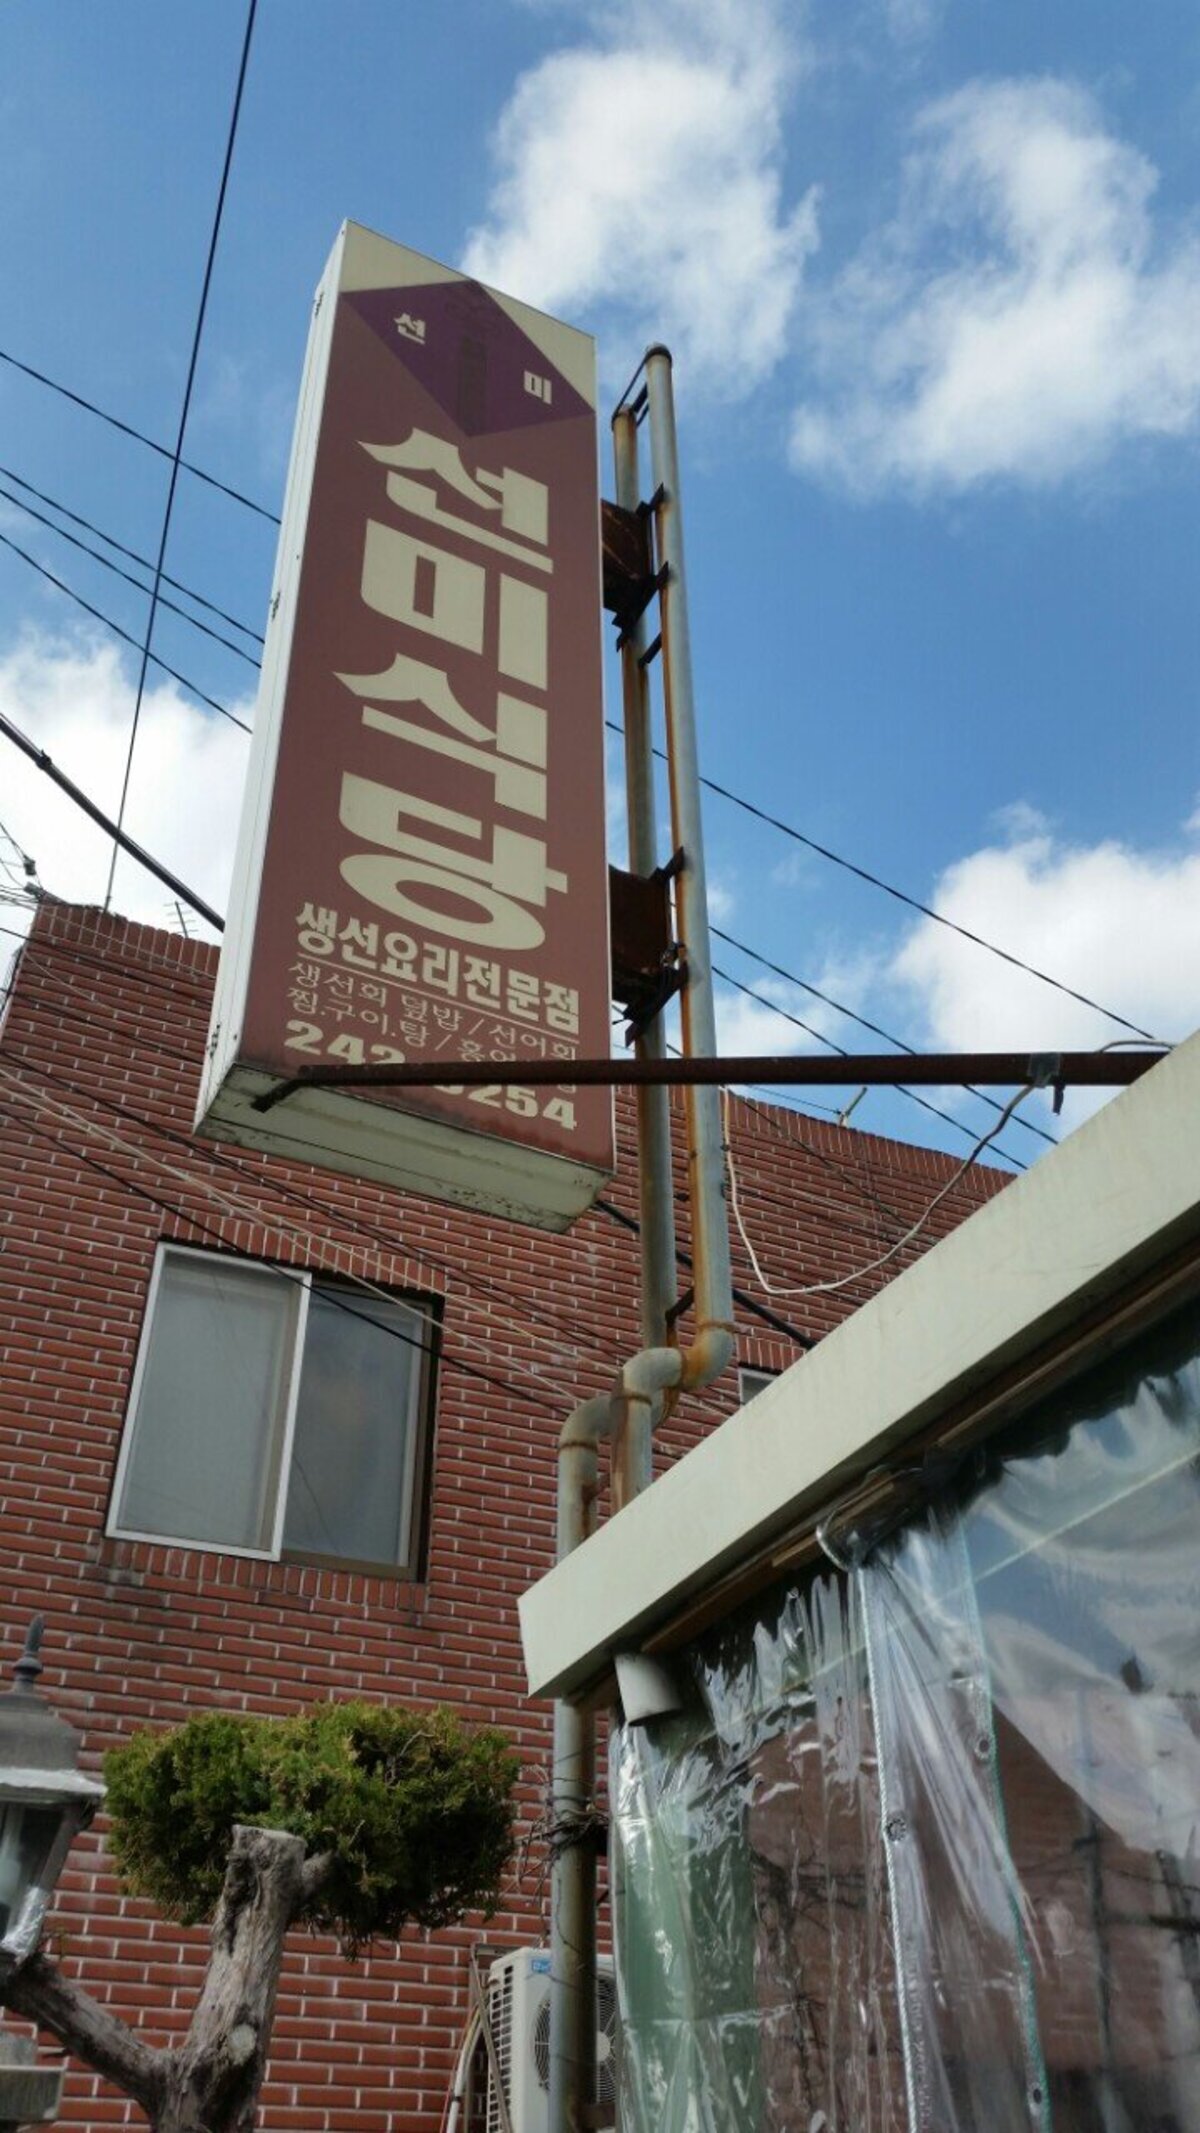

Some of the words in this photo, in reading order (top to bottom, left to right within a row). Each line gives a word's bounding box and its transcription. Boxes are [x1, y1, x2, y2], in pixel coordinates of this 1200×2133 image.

[393, 313, 427, 345] 선
[523, 370, 553, 405] 미
[332, 428, 568, 951] 선미식당
[288, 961, 387, 1008] 생선회
[295, 901, 580, 1036] 생선요리전문점
